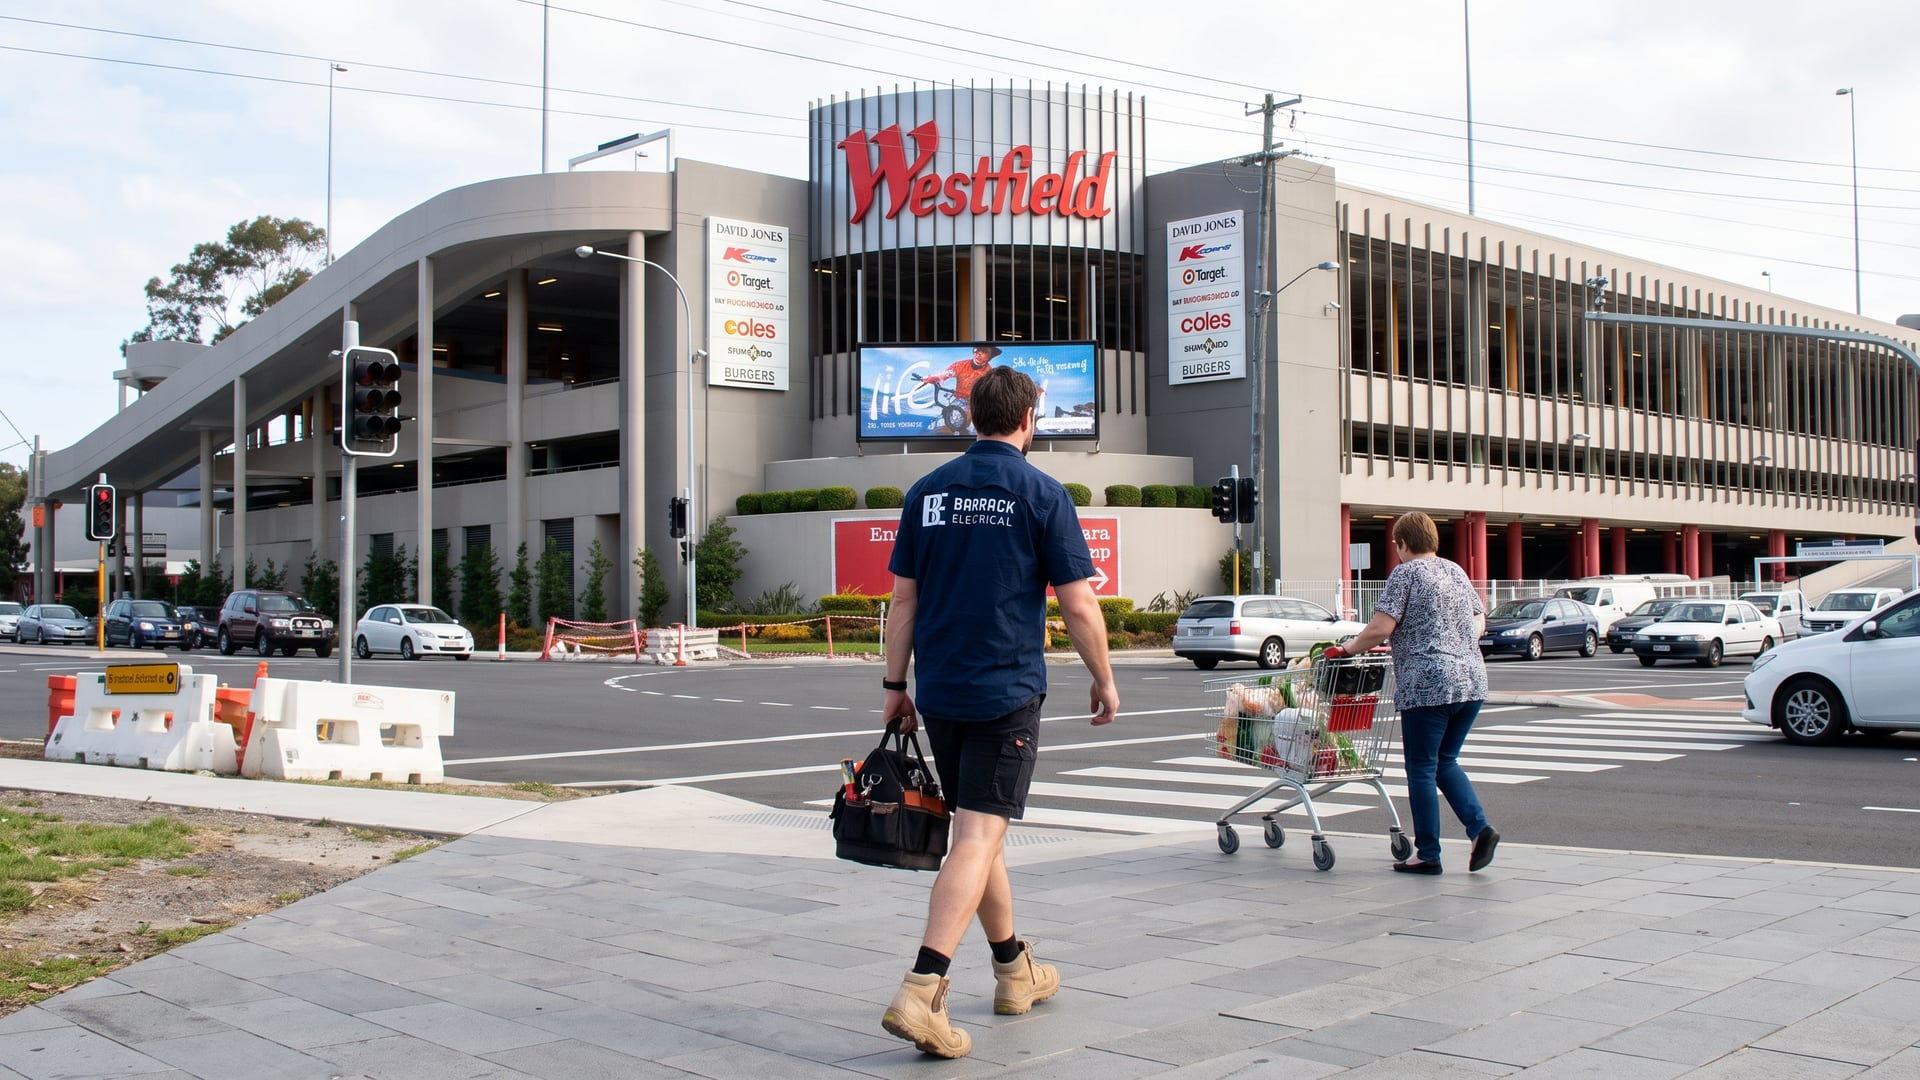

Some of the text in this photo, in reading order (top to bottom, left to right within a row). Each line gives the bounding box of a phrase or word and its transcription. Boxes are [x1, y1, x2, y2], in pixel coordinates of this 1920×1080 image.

[838, 119, 1118, 224] Westfield
[716, 223, 783, 242] DAVID JONES
[1172, 217, 1236, 238] DAVID JONES
[741, 273, 771, 291] Target
[1195, 266, 1226, 282] Target
[724, 318, 776, 339] coles
[1181, 311, 1231, 333] coles
[724, 367, 775, 381] BURGERS
[1182, 360, 1231, 375] BURGERS
[870, 360, 935, 420] life
[954, 497, 1016, 514] BARRACK
[952, 514, 1012, 527] ELECRICAL
[870, 527, 898, 542] En
